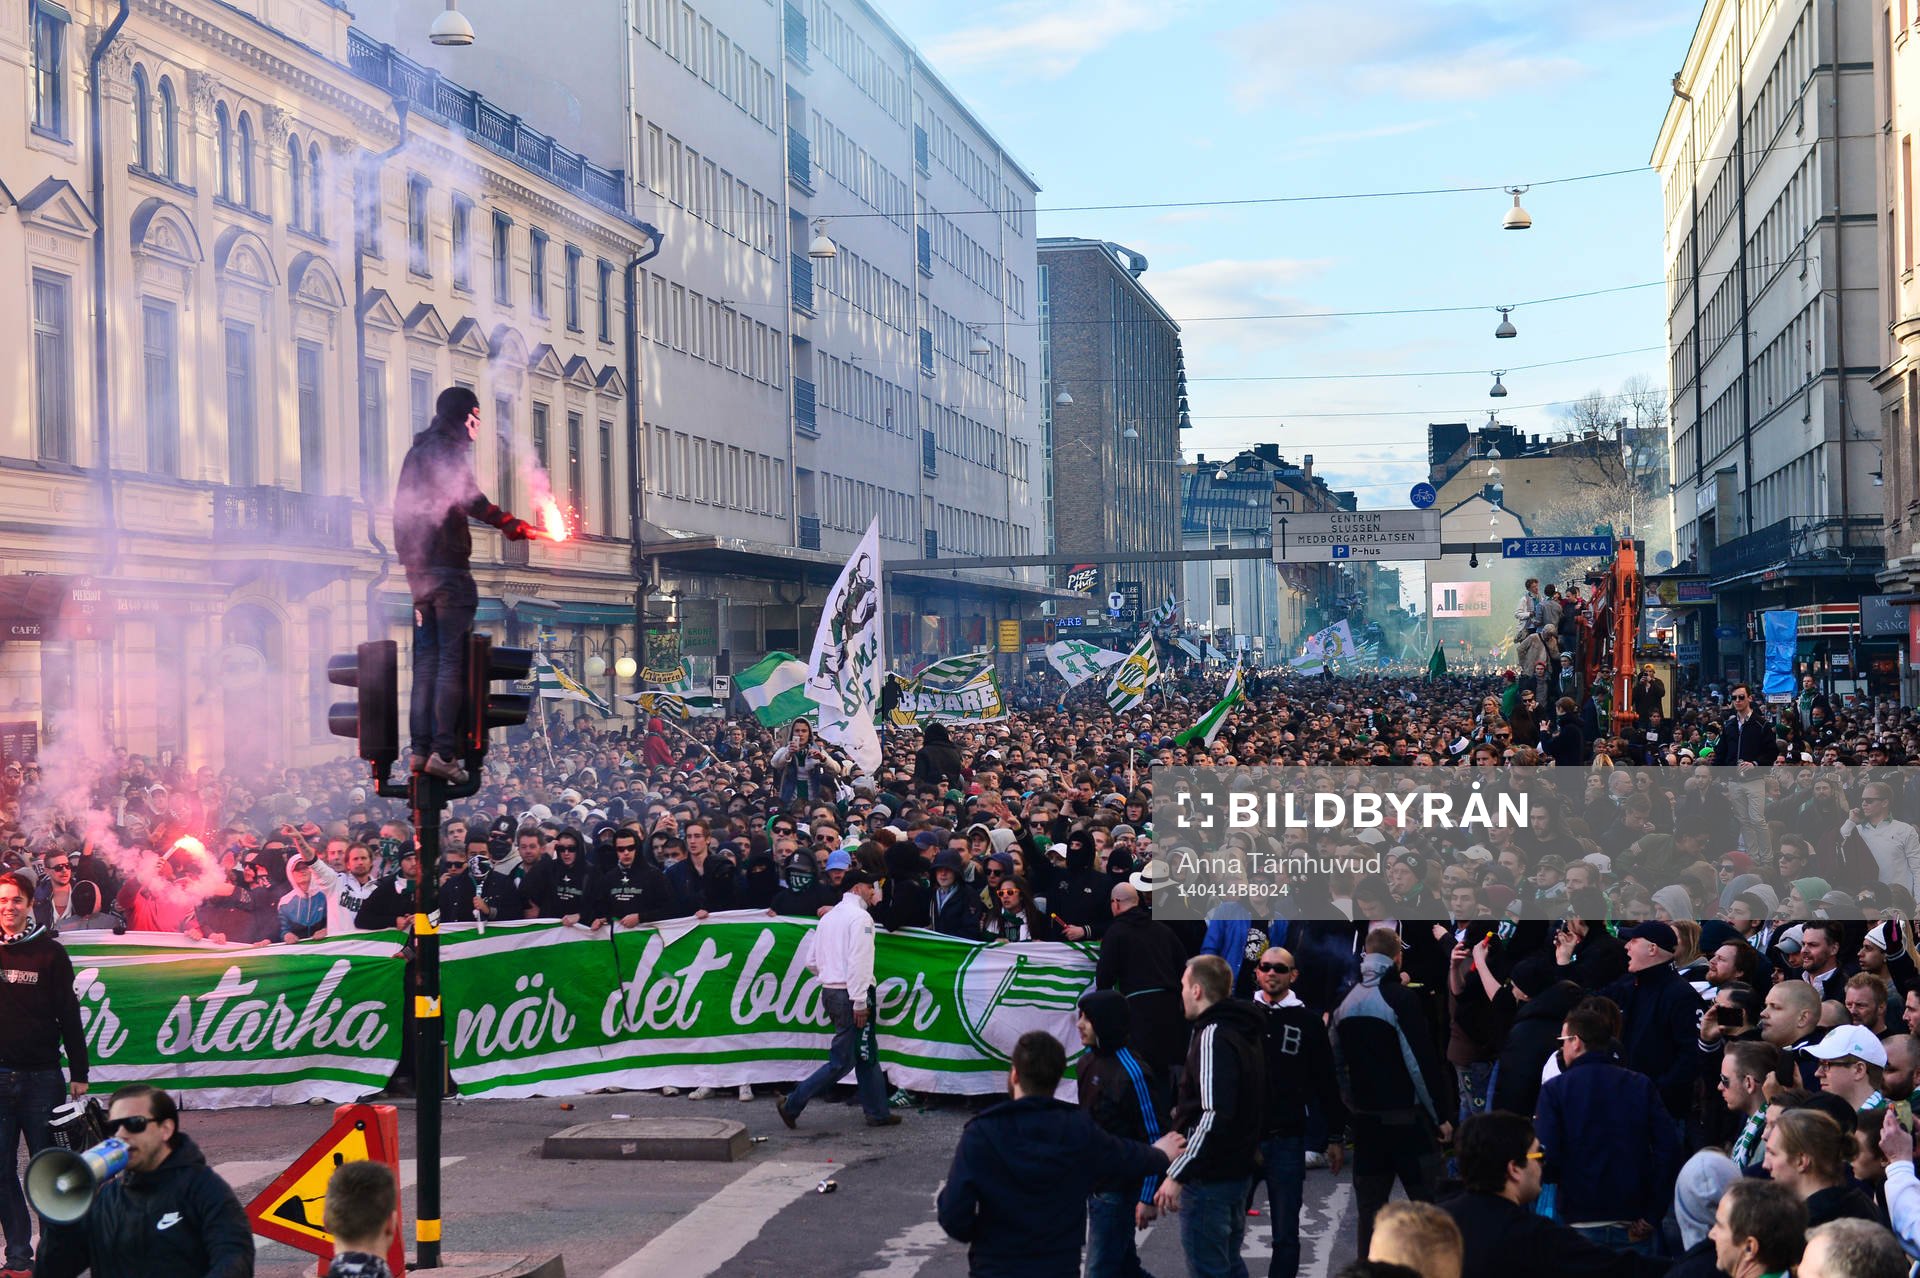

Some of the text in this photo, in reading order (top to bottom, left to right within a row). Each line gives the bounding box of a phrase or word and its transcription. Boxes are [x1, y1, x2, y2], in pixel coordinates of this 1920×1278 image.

[1330, 513, 1382, 523] CENTRUM
[1331, 524, 1381, 533] SLUSSEN
[1297, 533, 1416, 544] MEDBORGARPLATSEN
[1351, 547, 1381, 556] P-hus
[1532, 542, 1607, 552] 222 NACKA
[1067, 568, 1098, 589] Pizza
[1074, 576, 1096, 592] Hut
[11, 624, 41, 634] CAFÉ
[156, 958, 389, 1056] starka
[454, 973, 576, 1060] när
[601, 933, 733, 1038] det
[730, 927, 941, 1032] bler
[1281, 1023, 1301, 1056] B
